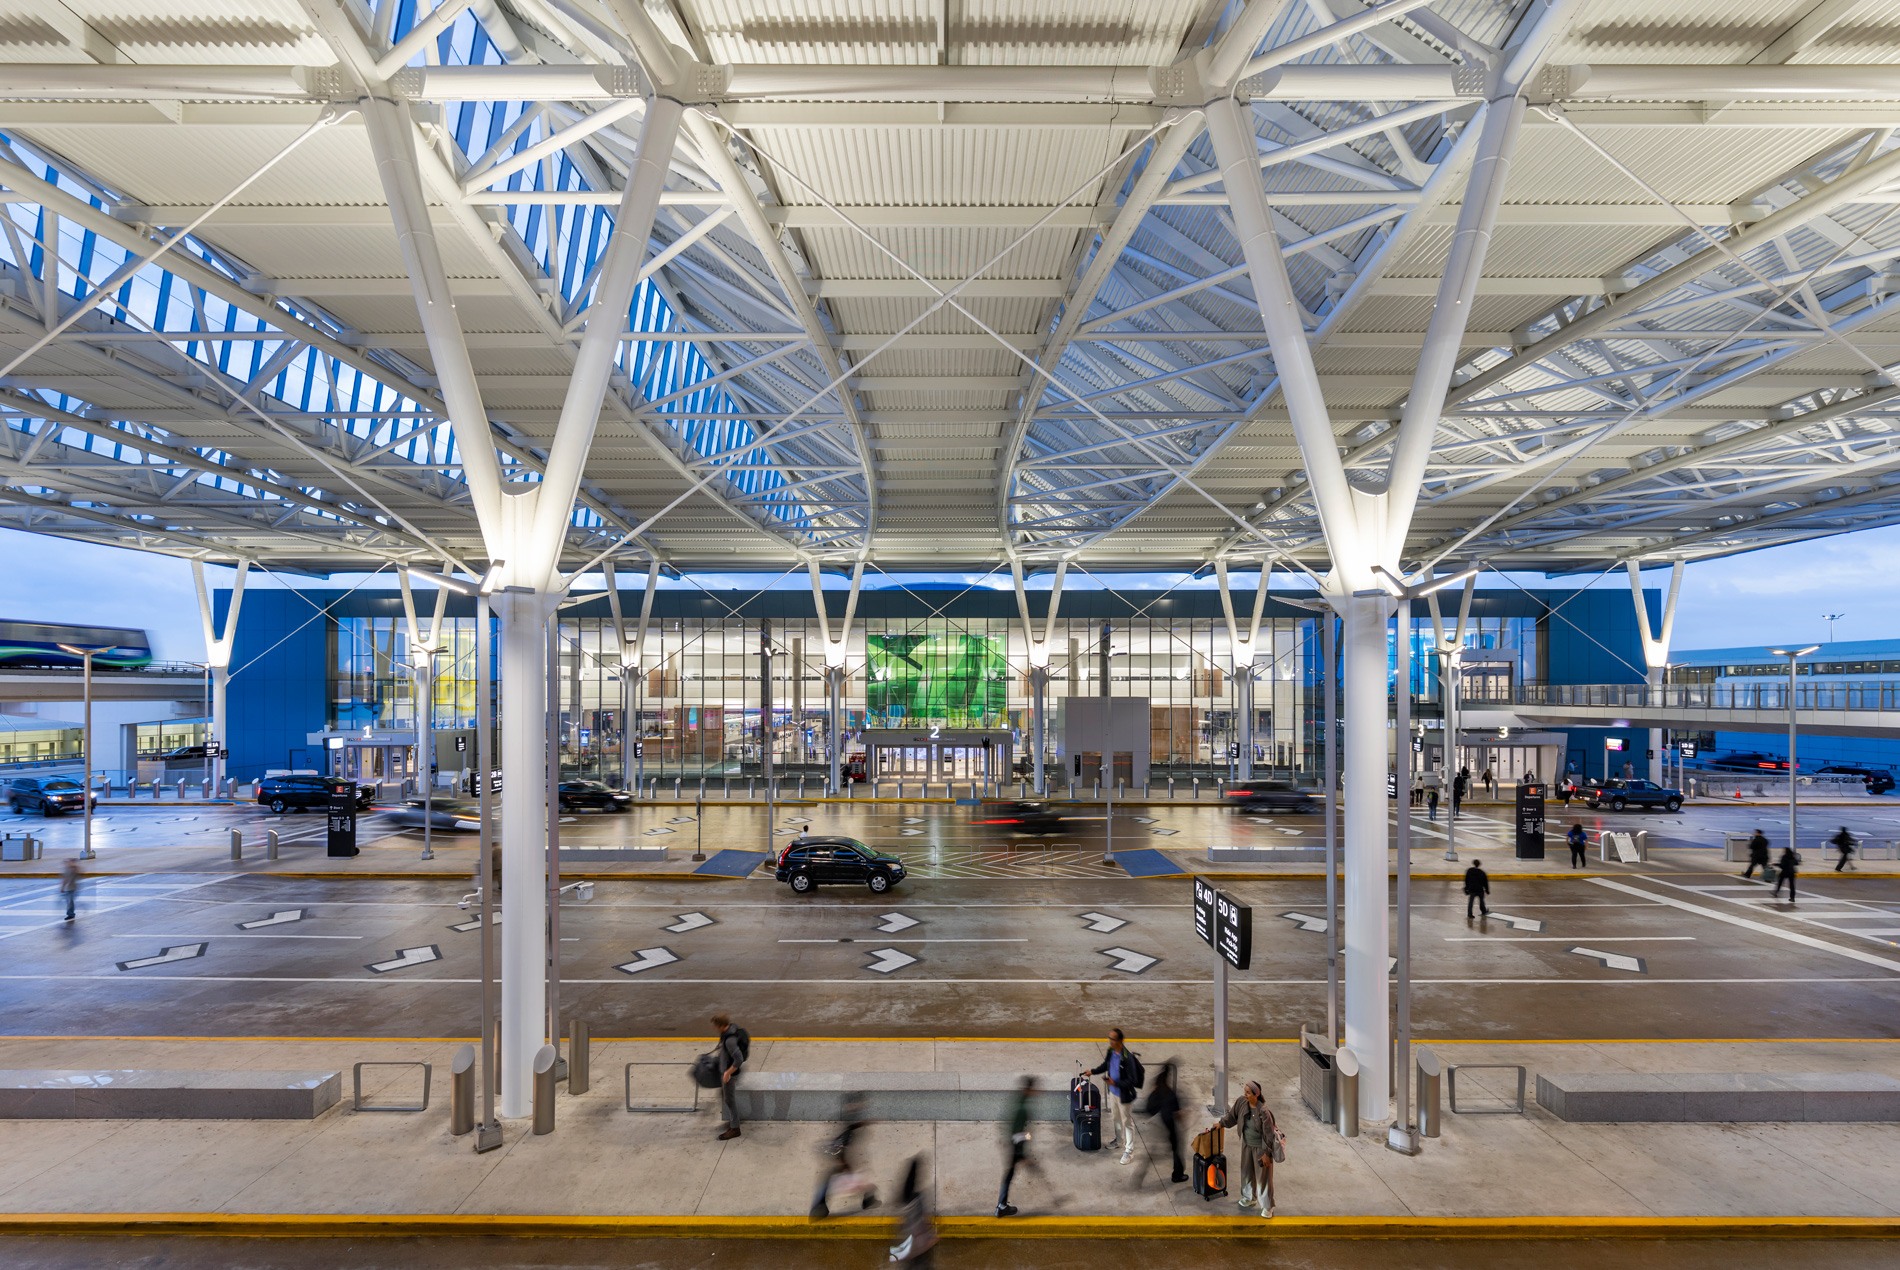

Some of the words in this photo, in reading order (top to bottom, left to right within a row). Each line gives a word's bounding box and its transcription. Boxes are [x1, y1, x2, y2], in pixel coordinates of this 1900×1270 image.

[363, 725, 372, 739] 1
[930, 726, 939, 738] 2
[1418, 724, 1424, 737] 3
[1498, 726, 1508, 739] 3
[1203, 888, 1213, 906] 4D
[1218, 898, 1229, 917] 5D
